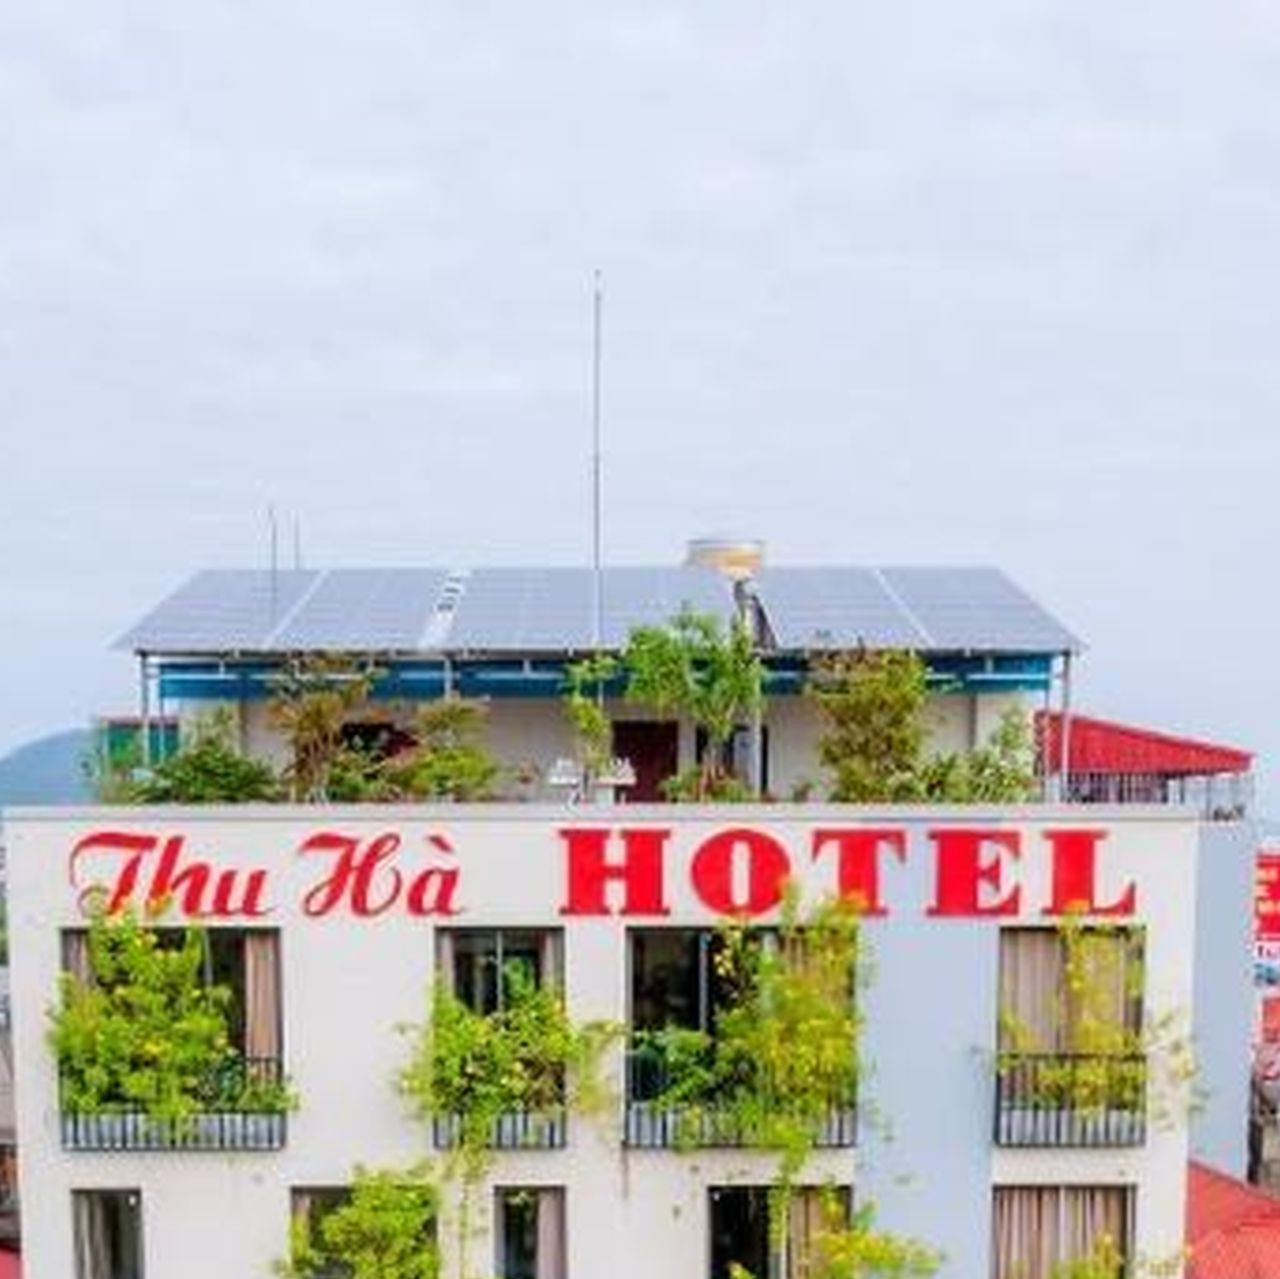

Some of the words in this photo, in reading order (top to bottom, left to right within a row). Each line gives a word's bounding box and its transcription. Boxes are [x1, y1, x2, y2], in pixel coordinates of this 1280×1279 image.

[69, 832, 276, 917] Thu
[297, 832, 466, 918] Hà
[558, 828, 1138, 917] HOTEL
